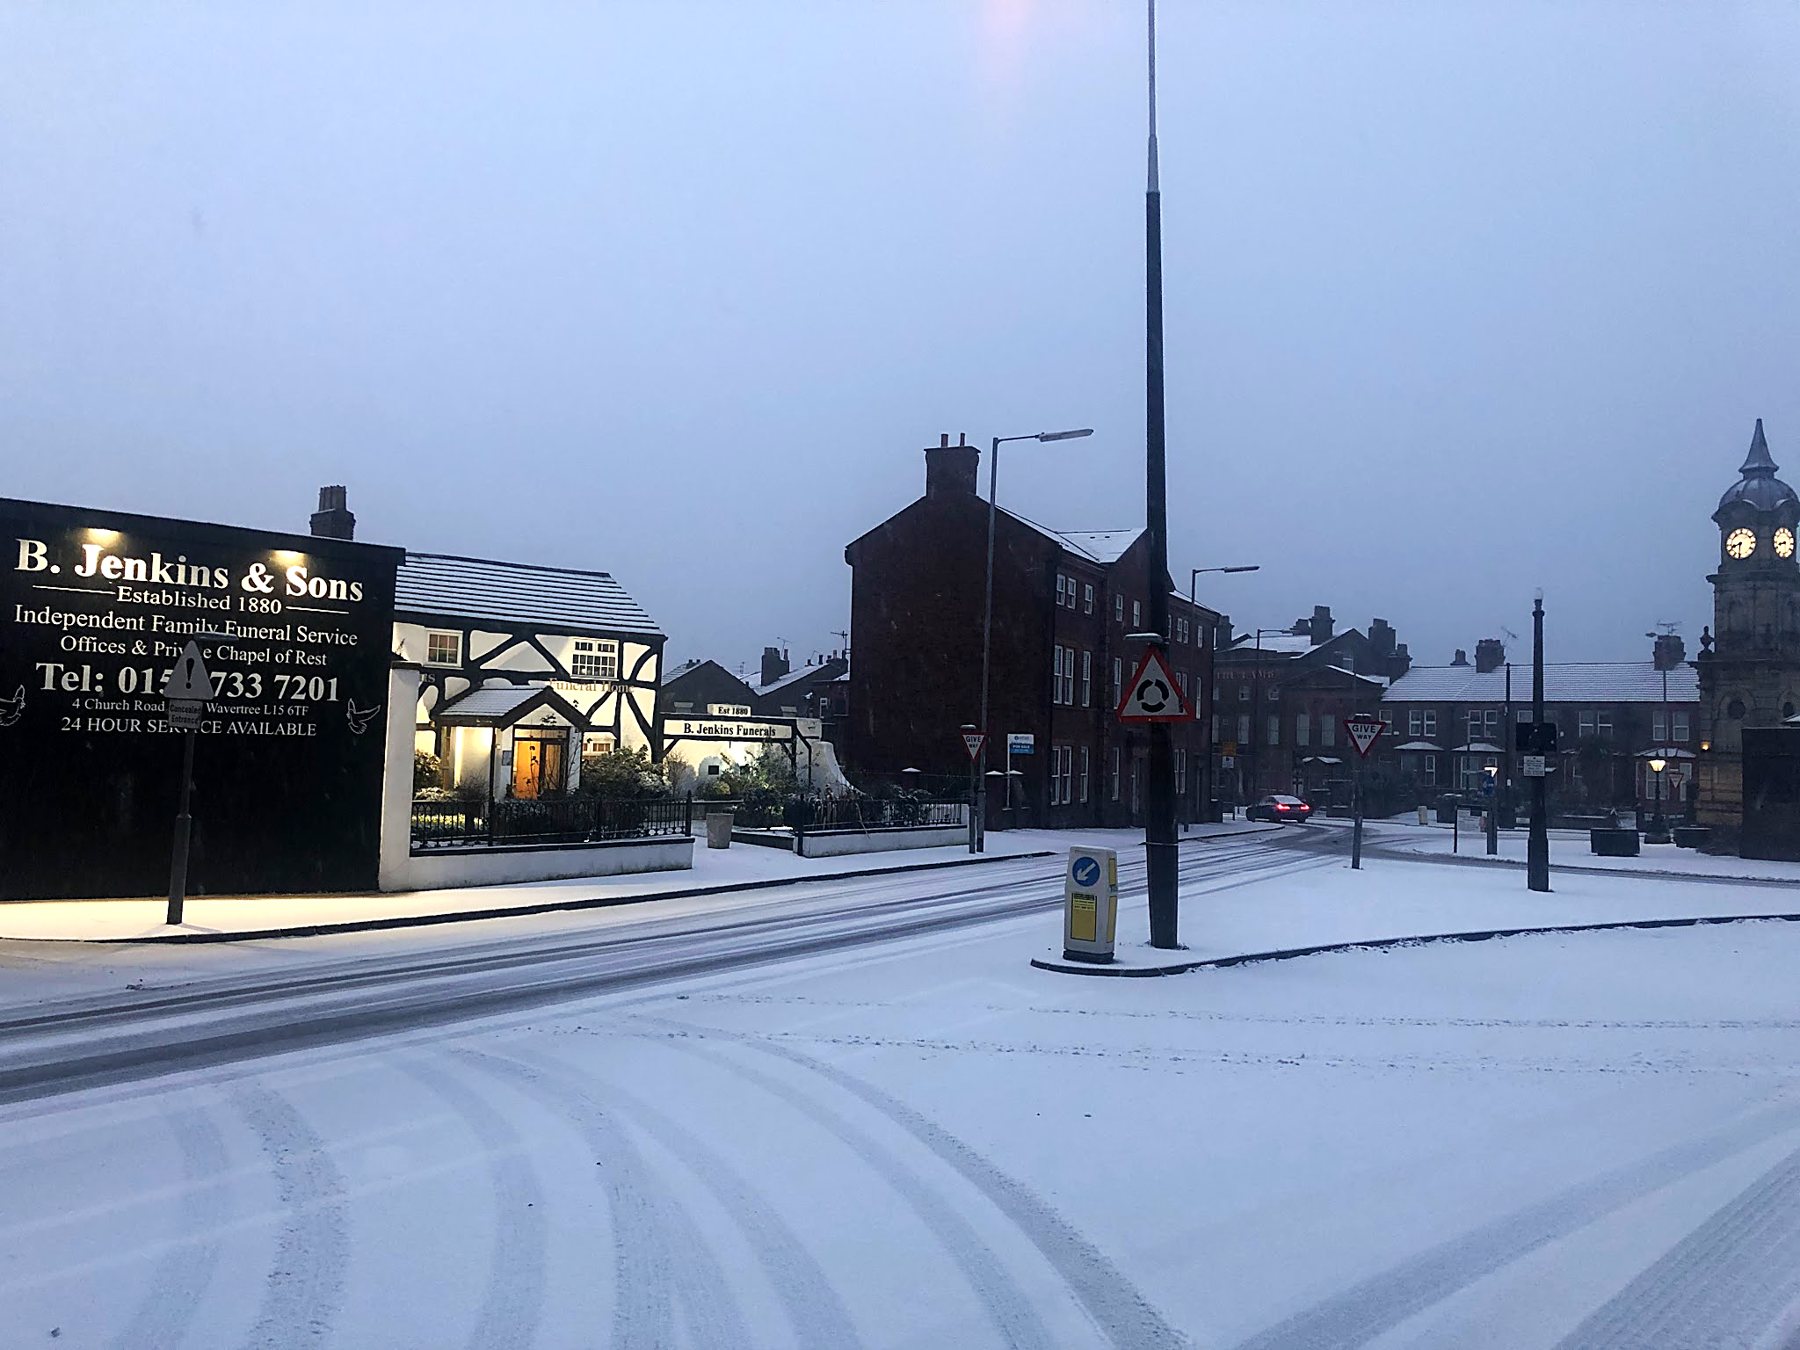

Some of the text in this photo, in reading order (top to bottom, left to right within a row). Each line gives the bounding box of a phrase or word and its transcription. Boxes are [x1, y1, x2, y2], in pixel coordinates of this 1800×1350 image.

[14, 539, 363, 602] B. Jenkins & Sons
[117, 585, 282, 615] Established 1880
[14, 604, 358, 646] Independent Family Funeral Service
[60, 635, 126, 655] Offices
[131, 639, 147, 656] &
[217, 645, 271, 666] Chapel
[275, 649, 294, 664] of
[295, 650, 327, 666] Rest
[36, 662, 104, 693] Tel:
[209, 671, 262, 699] 733
[273, 674, 339, 702] 7201
[548, 677, 635, 693] Funeral Home
[72, 698, 309, 716] 4 Church Road Wavertree L15 6TF
[718, 706, 748, 715] Est 1880
[61, 716, 82, 731] 24
[87, 718, 142, 733] HOUR
[226, 721, 317, 736] AVAILABLE
[684, 723, 776, 736] B. Jenkins Funerals
[1351, 724, 1376, 733] GIVE
[965, 735, 981, 743] GIVE
